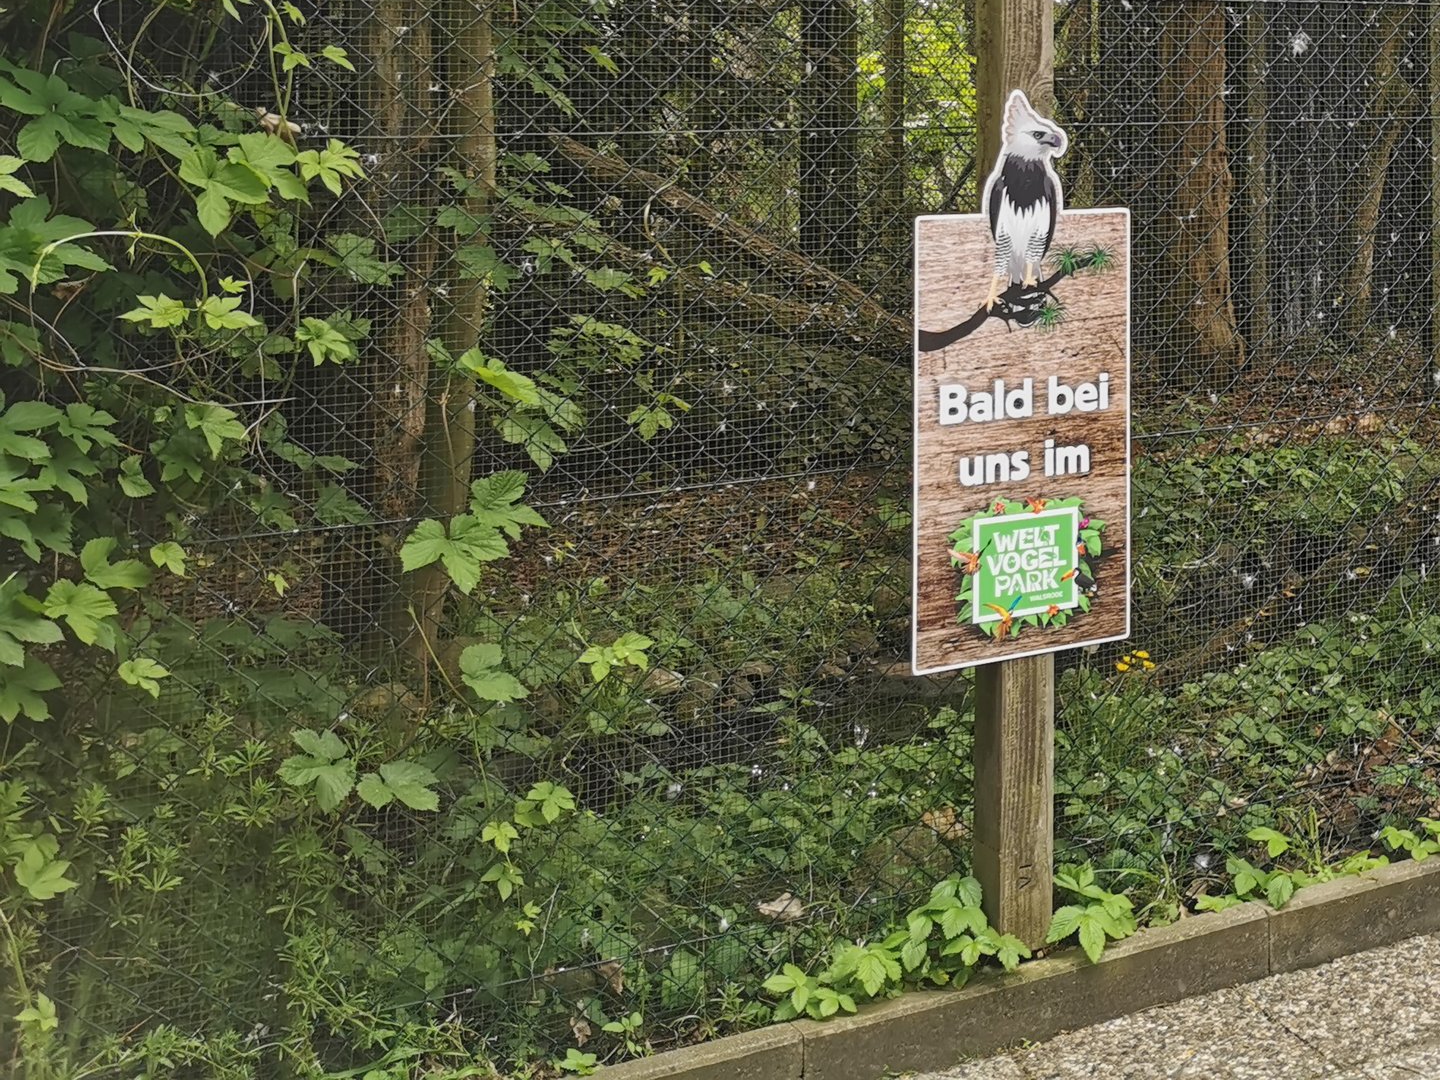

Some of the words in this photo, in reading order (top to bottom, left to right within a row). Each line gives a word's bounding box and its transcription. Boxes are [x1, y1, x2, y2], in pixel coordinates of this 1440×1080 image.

[939, 377, 1033, 425] Bald
[1048, 372, 1109, 415] bei
[959, 450, 1030, 487] uns
[1044, 438, 1090, 477] im
[992, 524, 1060, 553] WELT
[986, 546, 1067, 576] VOGEL
[994, 567, 1060, 598] PARK
